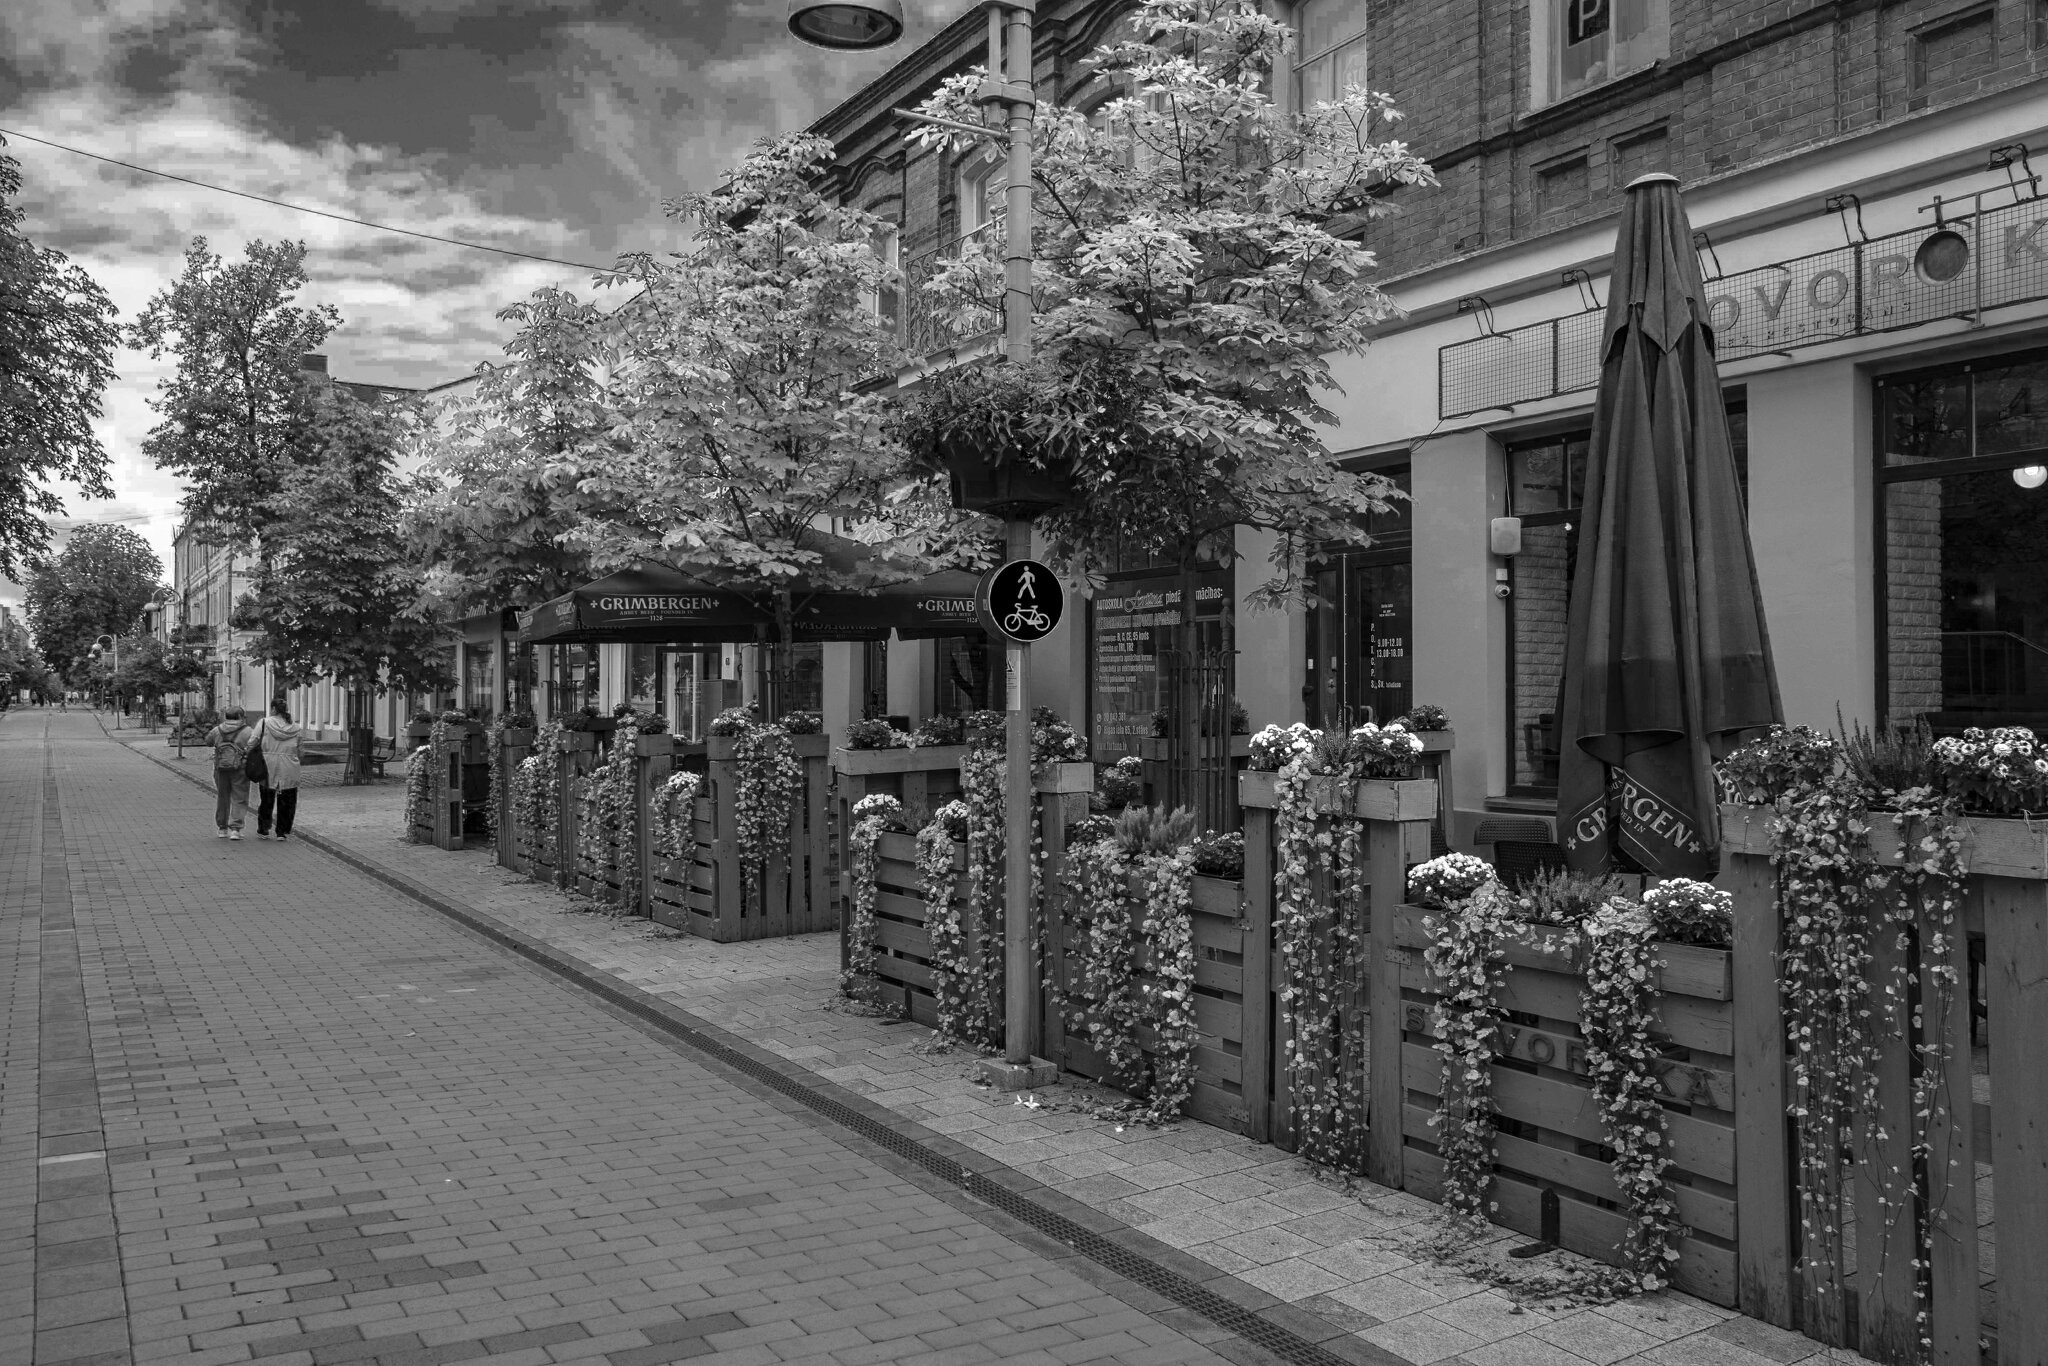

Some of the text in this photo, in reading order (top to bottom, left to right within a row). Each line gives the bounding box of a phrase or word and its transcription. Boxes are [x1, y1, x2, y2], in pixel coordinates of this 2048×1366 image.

[599, 597, 712, 610] GRIMBERGEN
[925, 599, 975, 612] GRIMB
[1096, 597, 1124, 610] AUTOSKOLA
